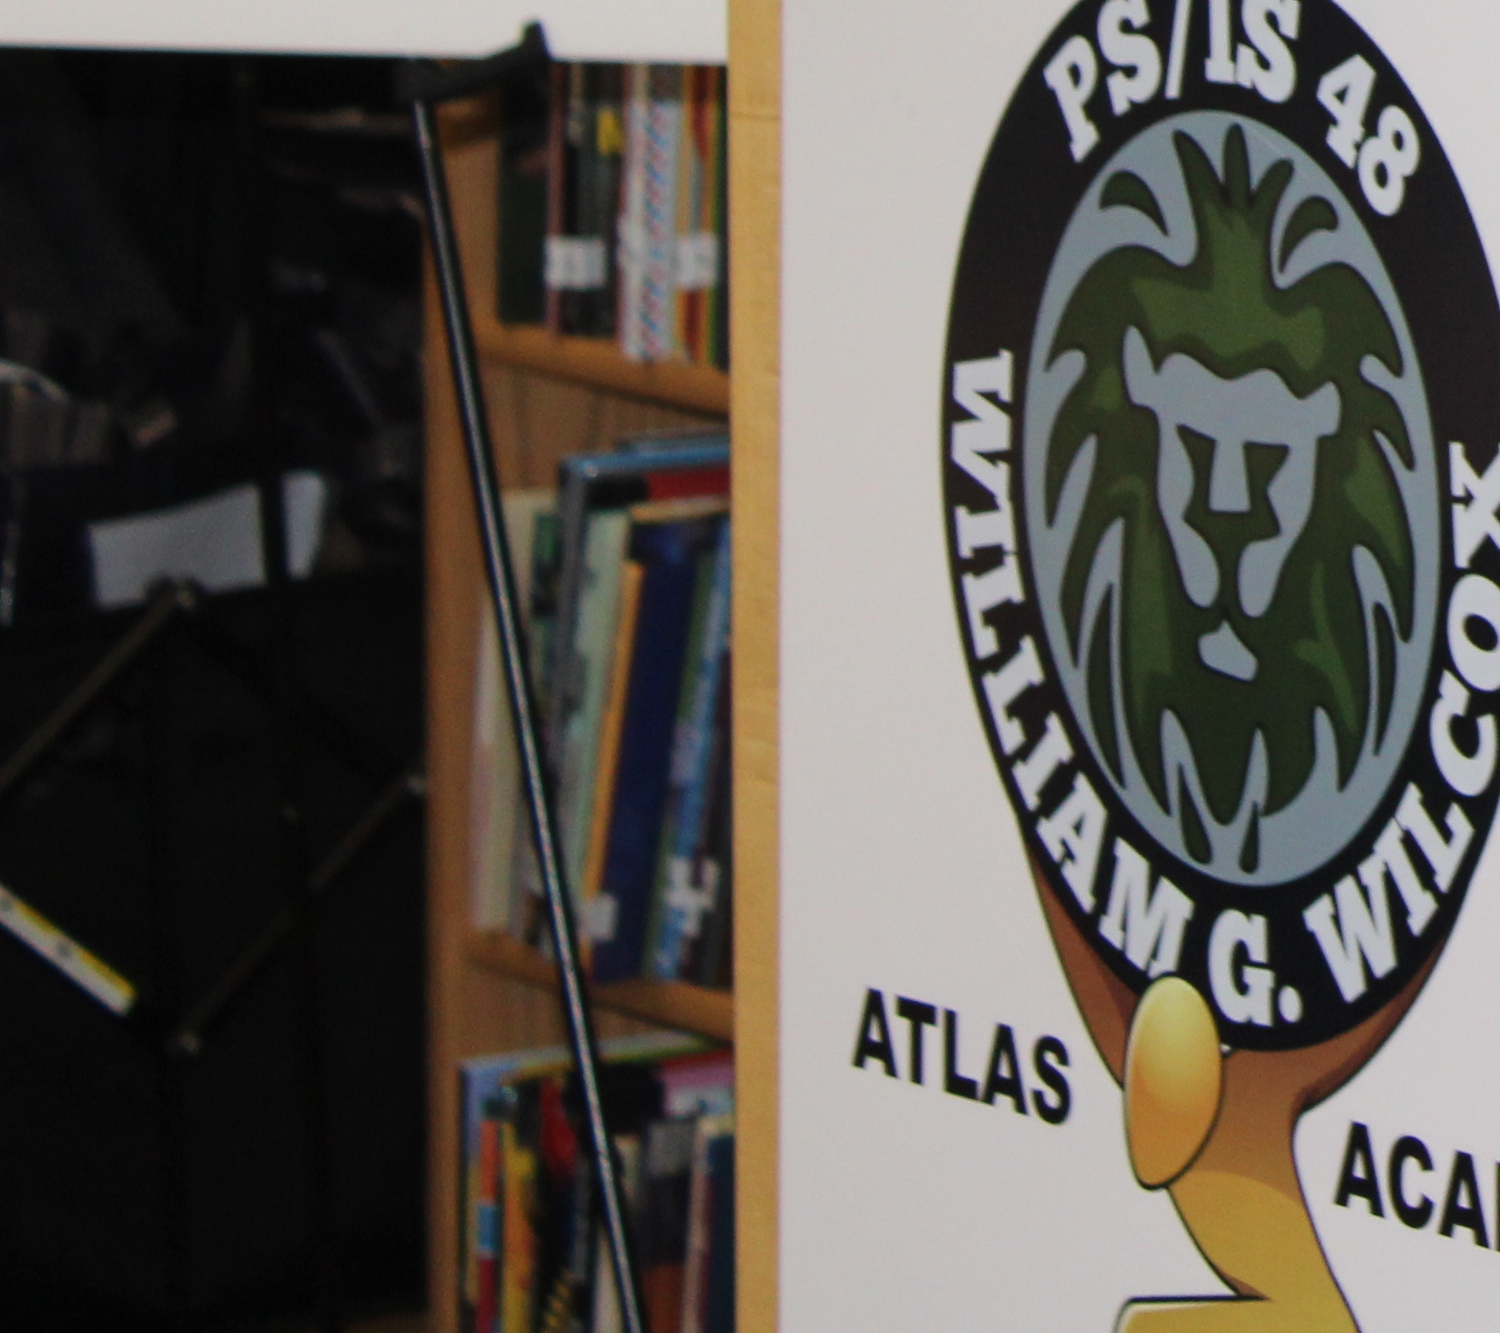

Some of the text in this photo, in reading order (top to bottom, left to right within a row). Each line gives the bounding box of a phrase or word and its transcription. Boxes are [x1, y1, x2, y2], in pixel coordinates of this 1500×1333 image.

[1315, 53, 1421, 217] 48
[952, 349, 1198, 981] WILLIAM
[1207, 905, 1304, 1028] G.
[852, 987, 1075, 1128] ATLAS
